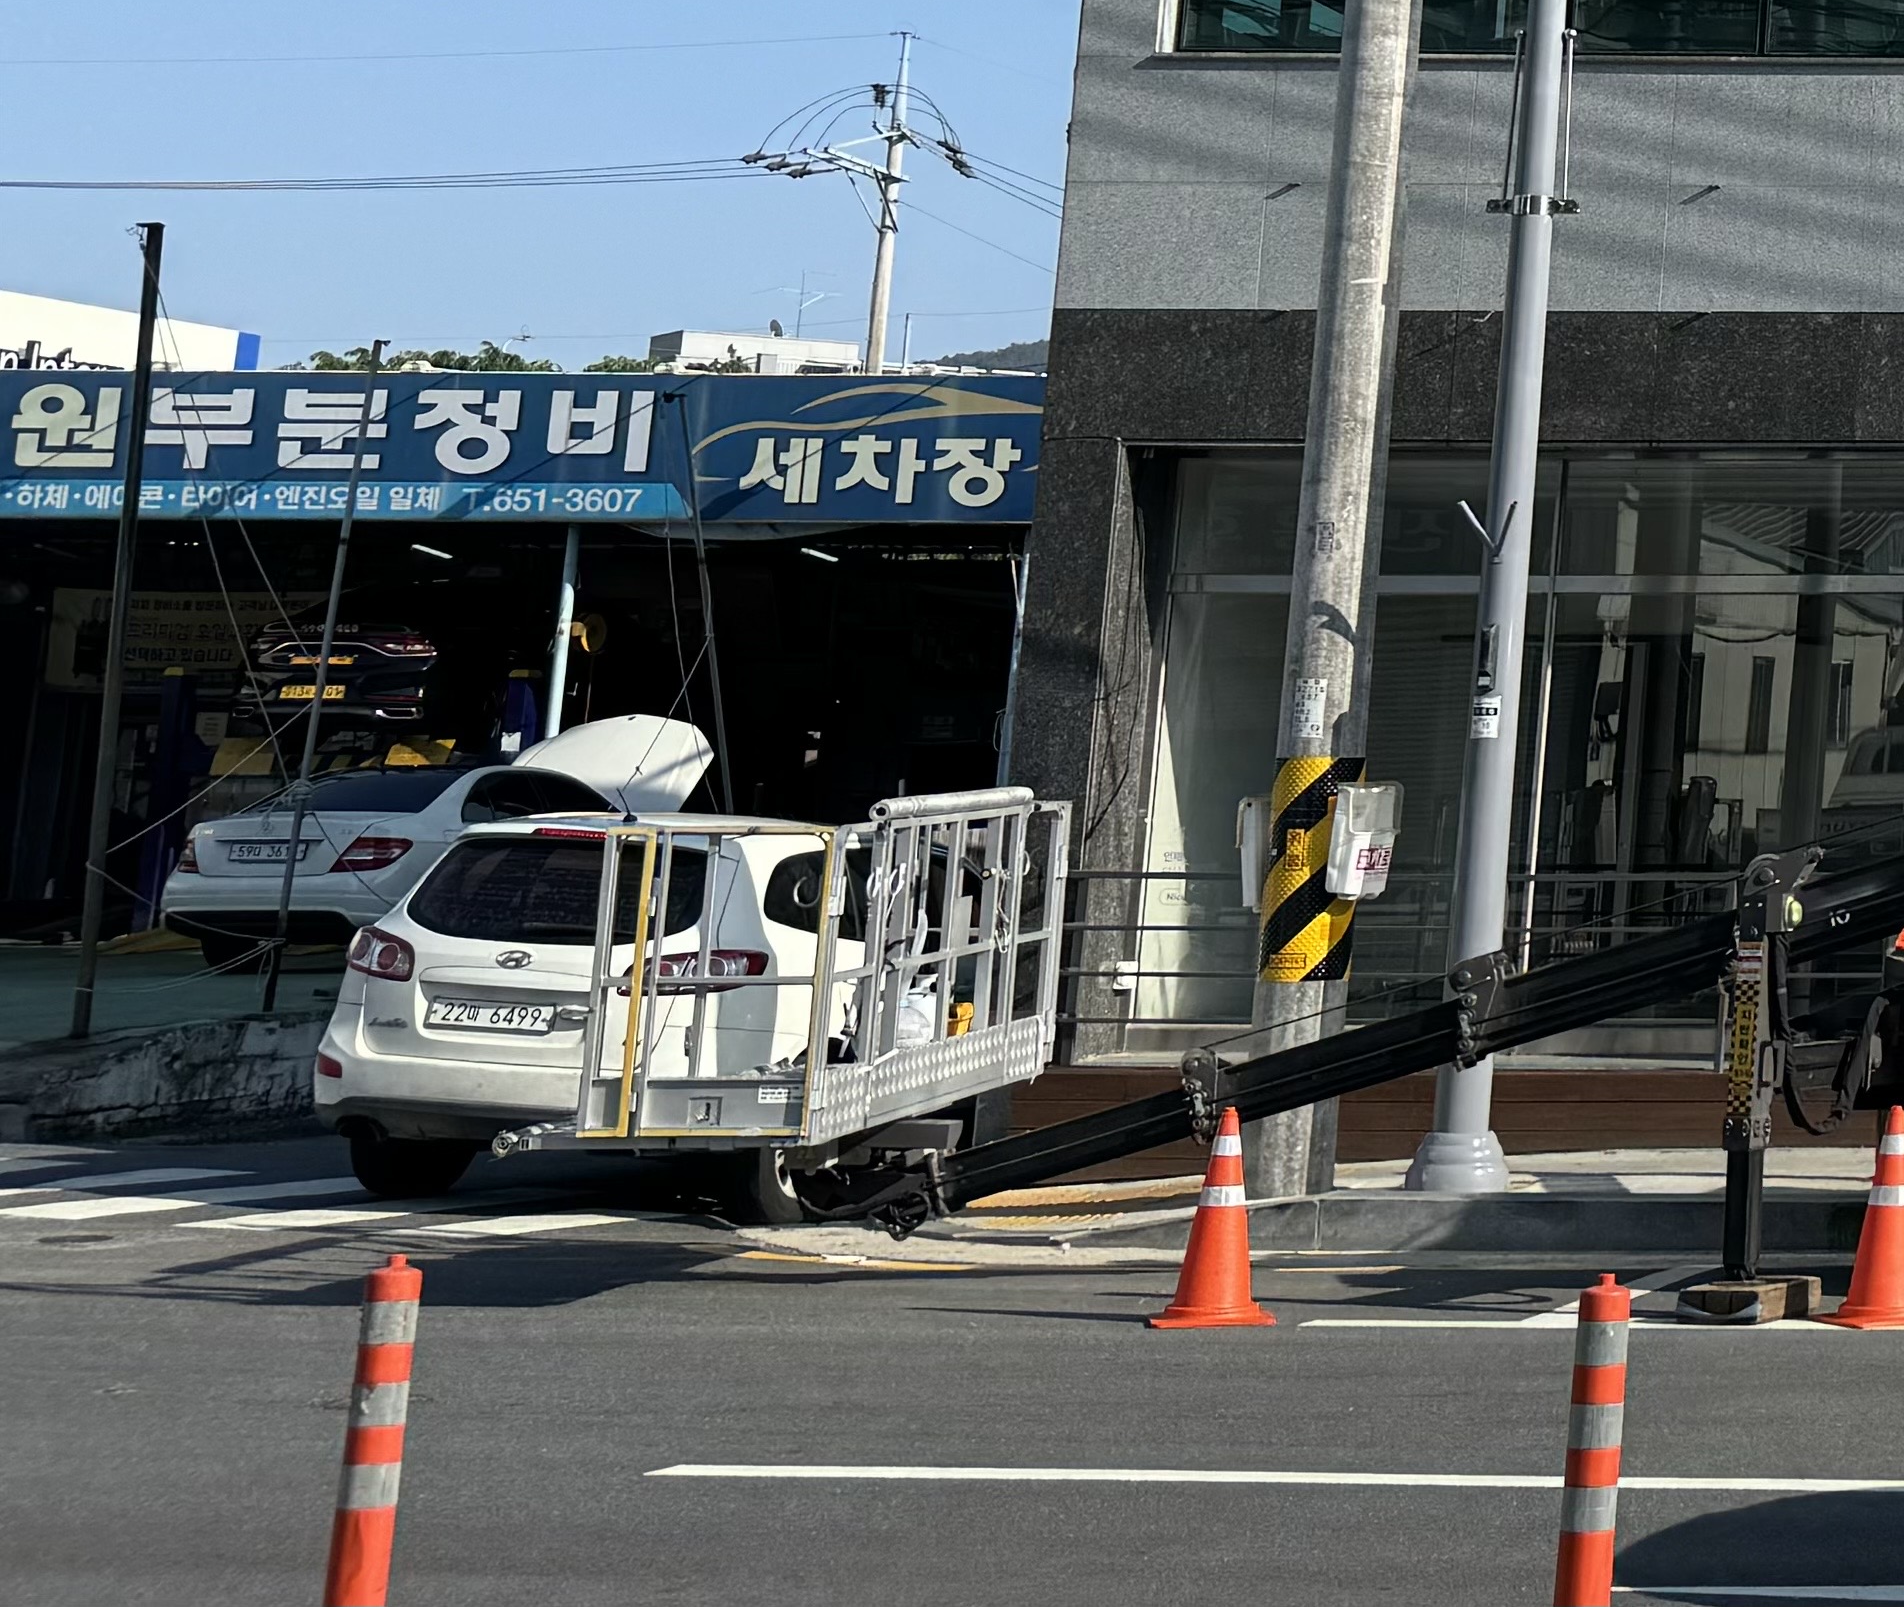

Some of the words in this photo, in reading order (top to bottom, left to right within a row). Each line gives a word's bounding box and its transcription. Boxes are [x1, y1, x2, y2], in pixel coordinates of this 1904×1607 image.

[739, 434, 1022, 509] 세차장
[389, 485, 440, 512] 일체
[489, 1005, 542, 1027] 6499
